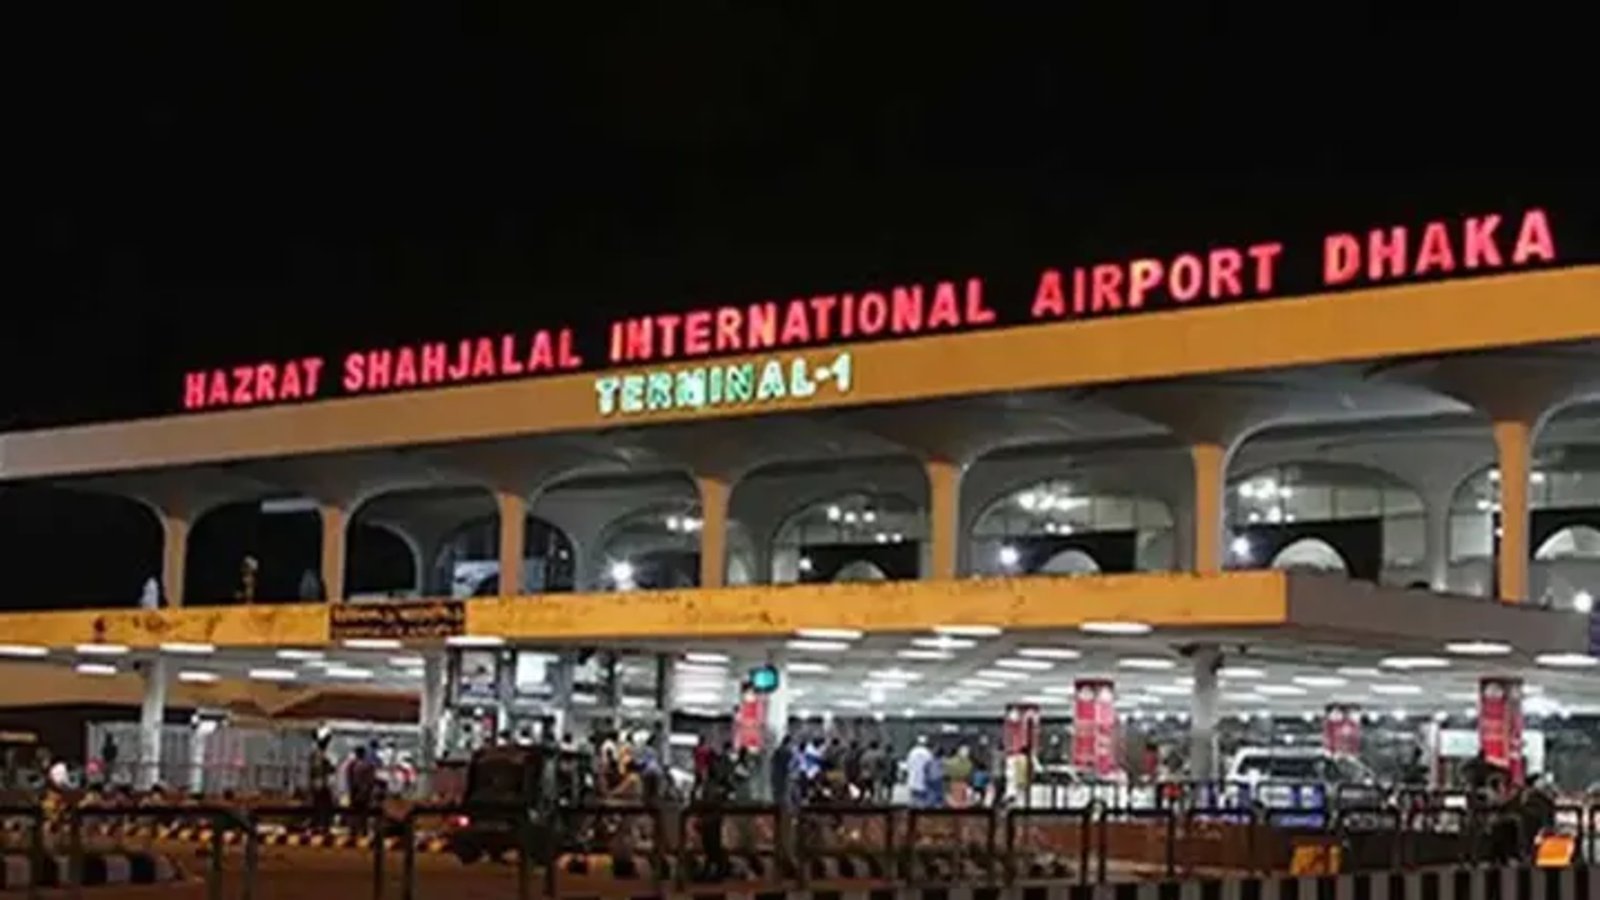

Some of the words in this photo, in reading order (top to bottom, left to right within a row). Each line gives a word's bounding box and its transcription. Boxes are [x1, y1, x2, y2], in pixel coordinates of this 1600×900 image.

[184, 357, 322, 408] HAZRAT
[343, 329, 582, 391] SHAHJALAL
[610, 279, 995, 363] INTERNATIONAL
[1032, 243, 1282, 316] AIRPORT
[1324, 209, 1555, 285] DHAKA
[595, 352, 851, 414] TERMINAL-1
